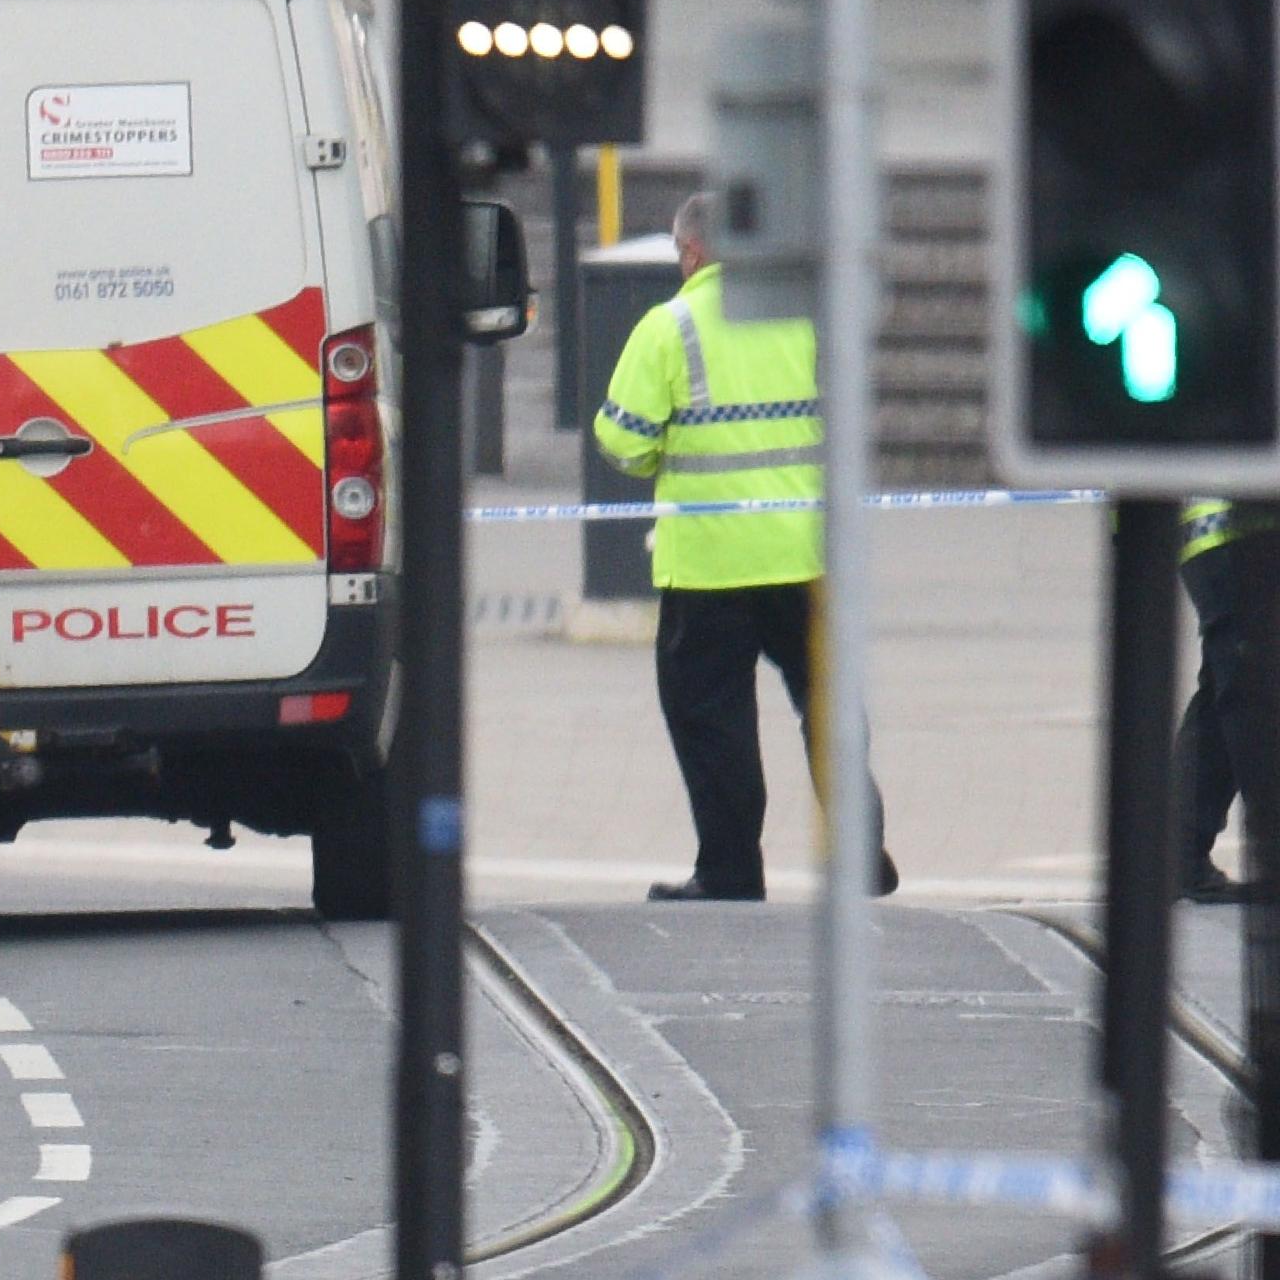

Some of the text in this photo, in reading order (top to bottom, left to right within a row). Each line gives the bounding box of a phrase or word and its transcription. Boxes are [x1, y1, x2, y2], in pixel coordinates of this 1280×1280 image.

[42, 129, 178, 145] CRIMESTOPPERS
[55, 278, 175, 300] 0161 872 5050
[12, 604, 256, 643] POLICE
